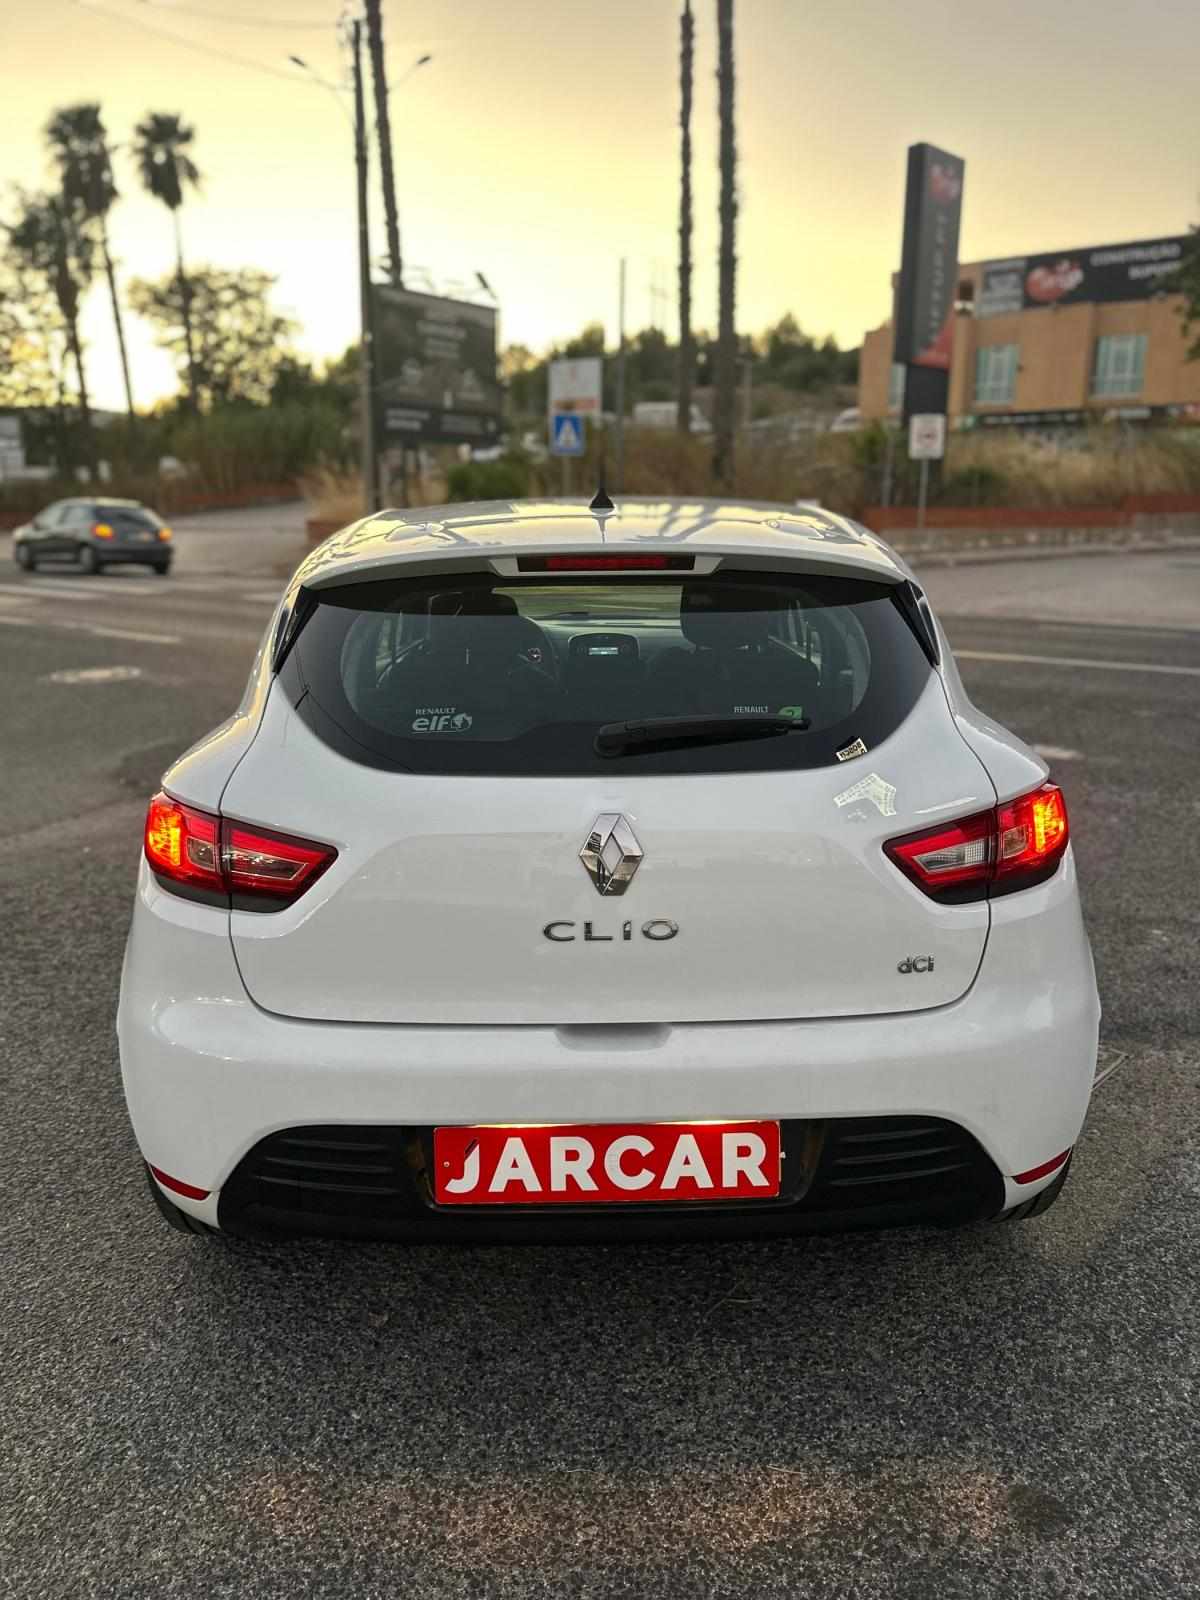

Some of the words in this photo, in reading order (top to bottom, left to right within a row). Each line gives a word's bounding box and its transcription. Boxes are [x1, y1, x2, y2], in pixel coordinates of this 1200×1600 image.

[415, 707, 457, 715] RENAULT
[733, 705, 768, 713] RENAULT
[412, 715, 451, 731] elf
[542, 919, 679, 942] CLIO
[897, 955, 935, 974] dCi
[444, 1131, 770, 1194] JARCAR
